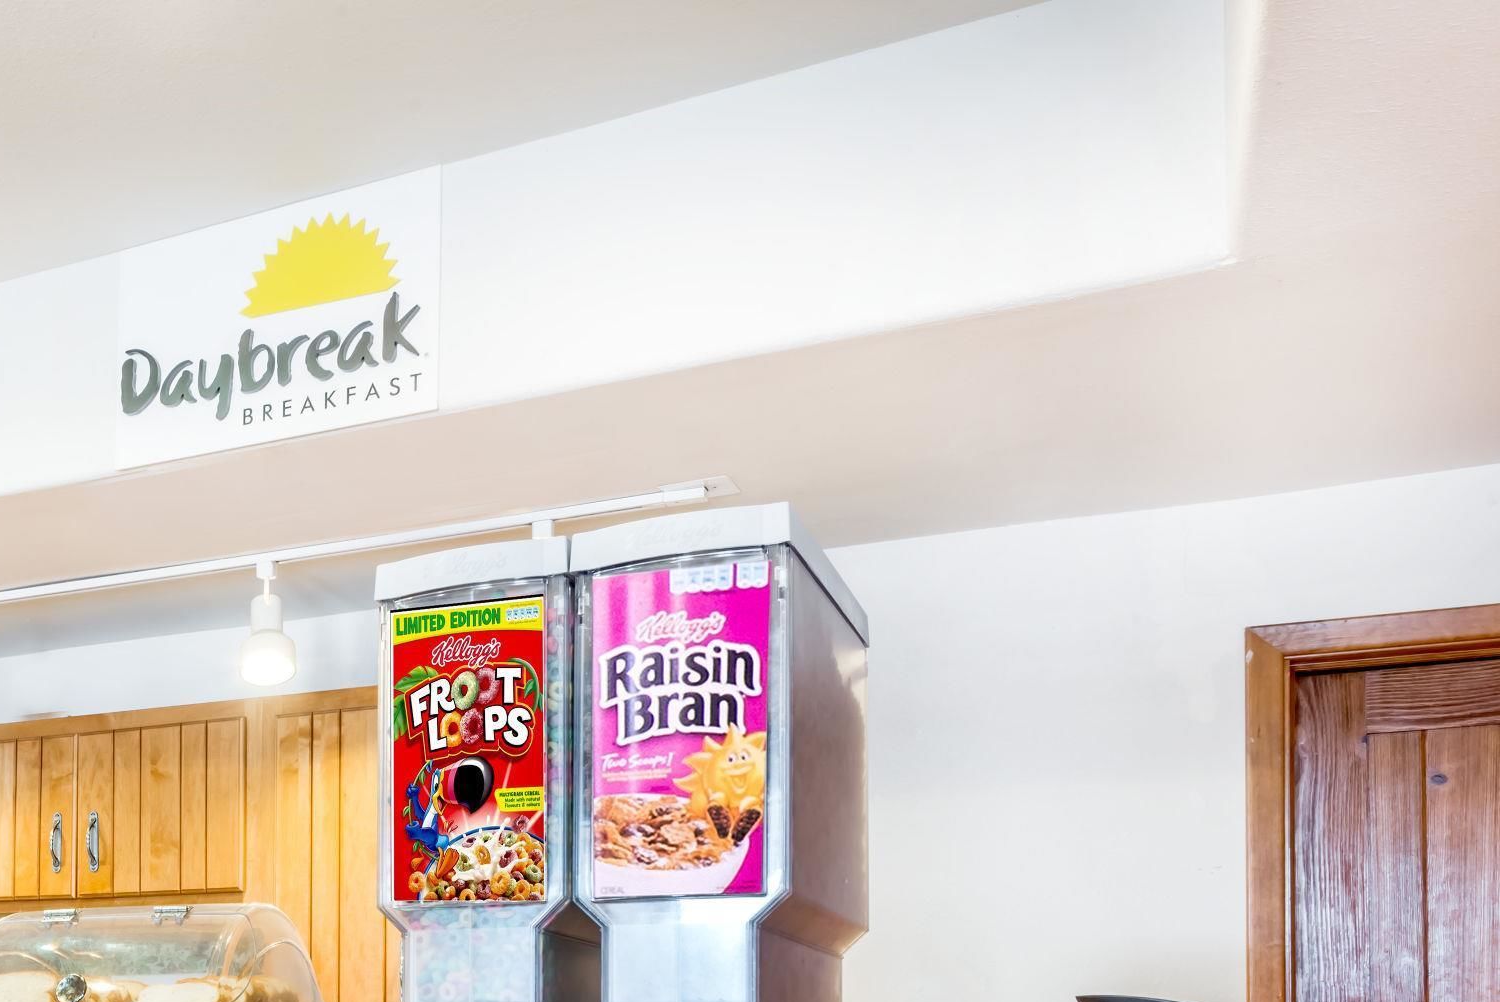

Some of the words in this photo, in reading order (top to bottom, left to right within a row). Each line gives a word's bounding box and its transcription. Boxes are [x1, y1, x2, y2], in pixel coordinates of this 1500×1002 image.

[121, 291, 421, 421] Daybreak
[242, 372, 423, 426] BREAKFAST
[396, 614, 445, 636] LIMITED
[450, 607, 501, 629] EDITION
[636, 611, 726, 643] Kellogg's
[431, 635, 501, 668] Kellogg's
[607, 646, 756, 701] Raisin
[410, 667, 522, 728] FROOT
[624, 691, 739, 738] Bran
[428, 705, 532, 751] LOOPS
